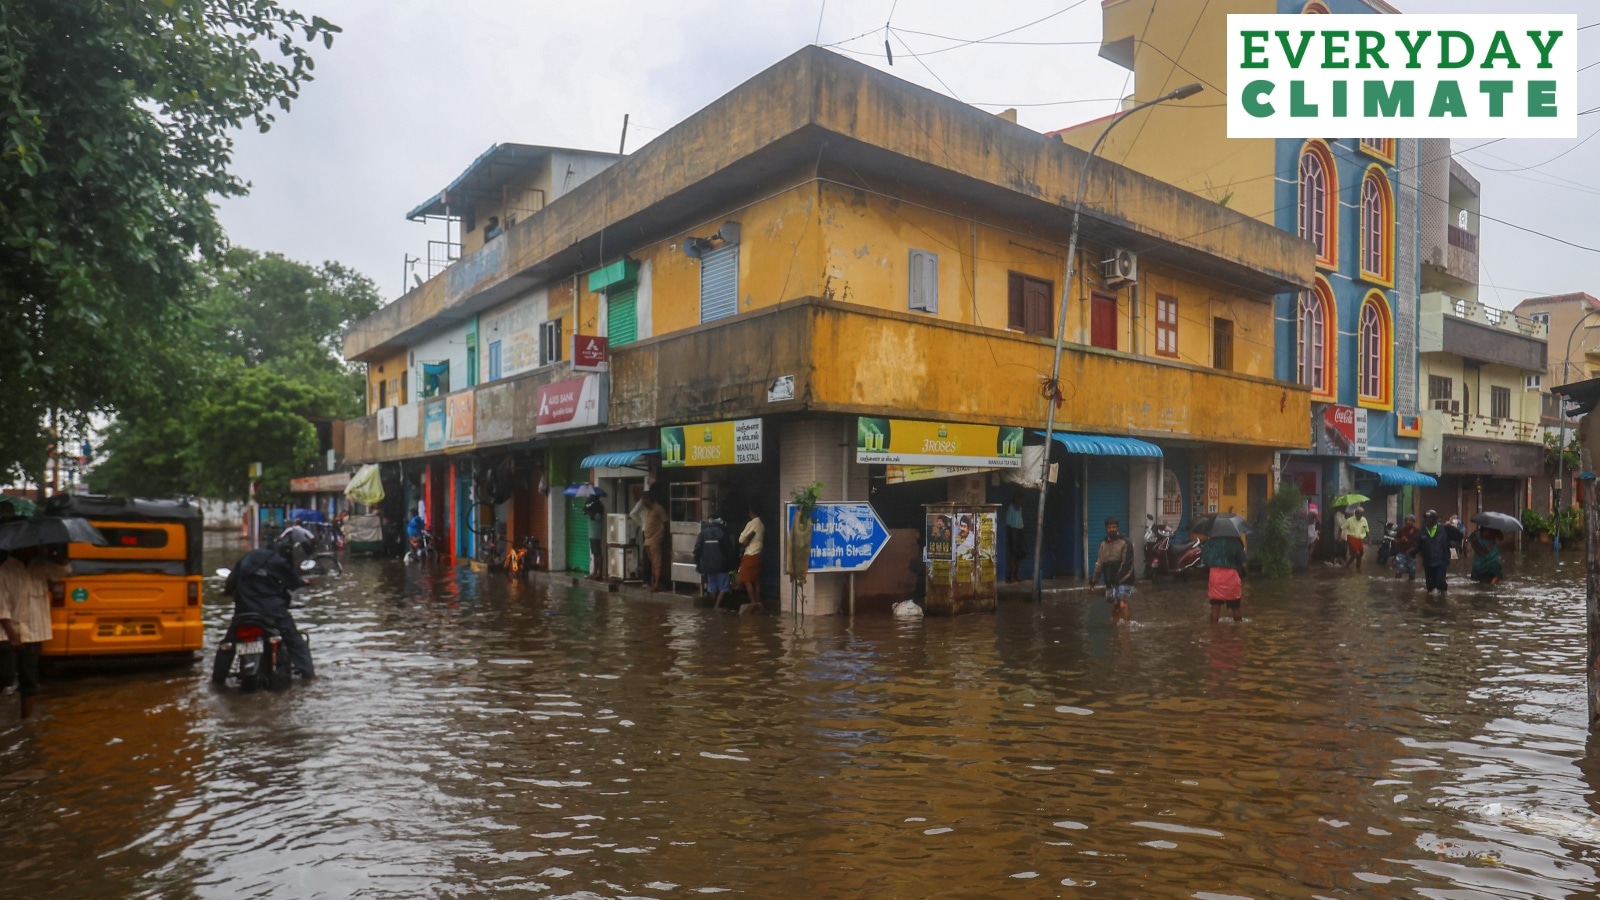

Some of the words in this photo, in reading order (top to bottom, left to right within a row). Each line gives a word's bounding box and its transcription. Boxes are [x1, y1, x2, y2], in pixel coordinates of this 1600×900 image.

[548, 395, 559, 404] AXIS
[560, 392, 574, 404] BANK
[585, 399, 596, 410] ATM
[736, 443, 759, 452] MANJULA
[737, 453, 746, 463] TEA
[746, 452, 759, 462] STALL
